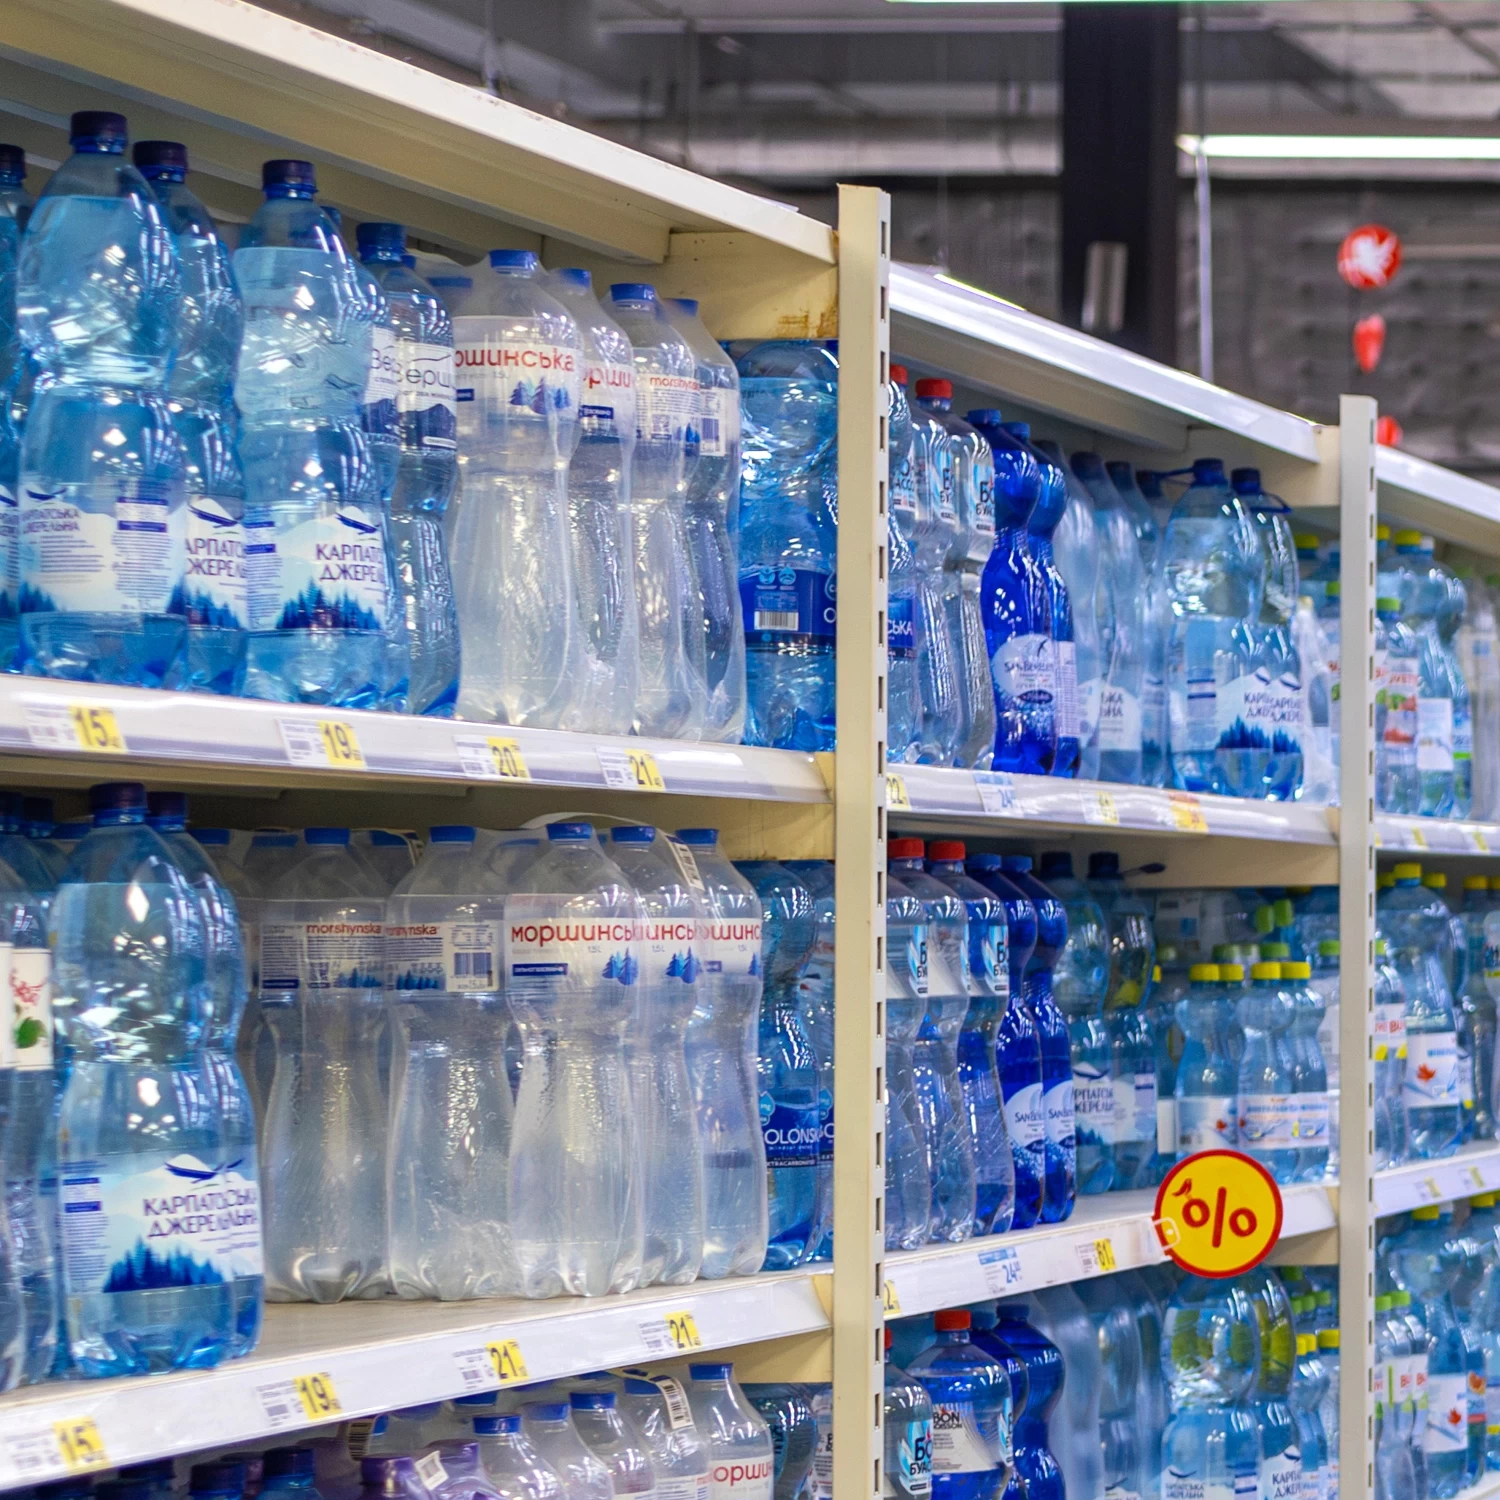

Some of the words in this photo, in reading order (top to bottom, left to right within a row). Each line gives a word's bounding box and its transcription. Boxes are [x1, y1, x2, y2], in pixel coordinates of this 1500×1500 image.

[74, 706, 108, 748] 15
[323, 722, 353, 760] 19
[629, 755, 653, 786] 21
[668, 1317, 692, 1348] 21
[490, 1344, 518, 1379] 21
[300, 1376, 330, 1415] 19
